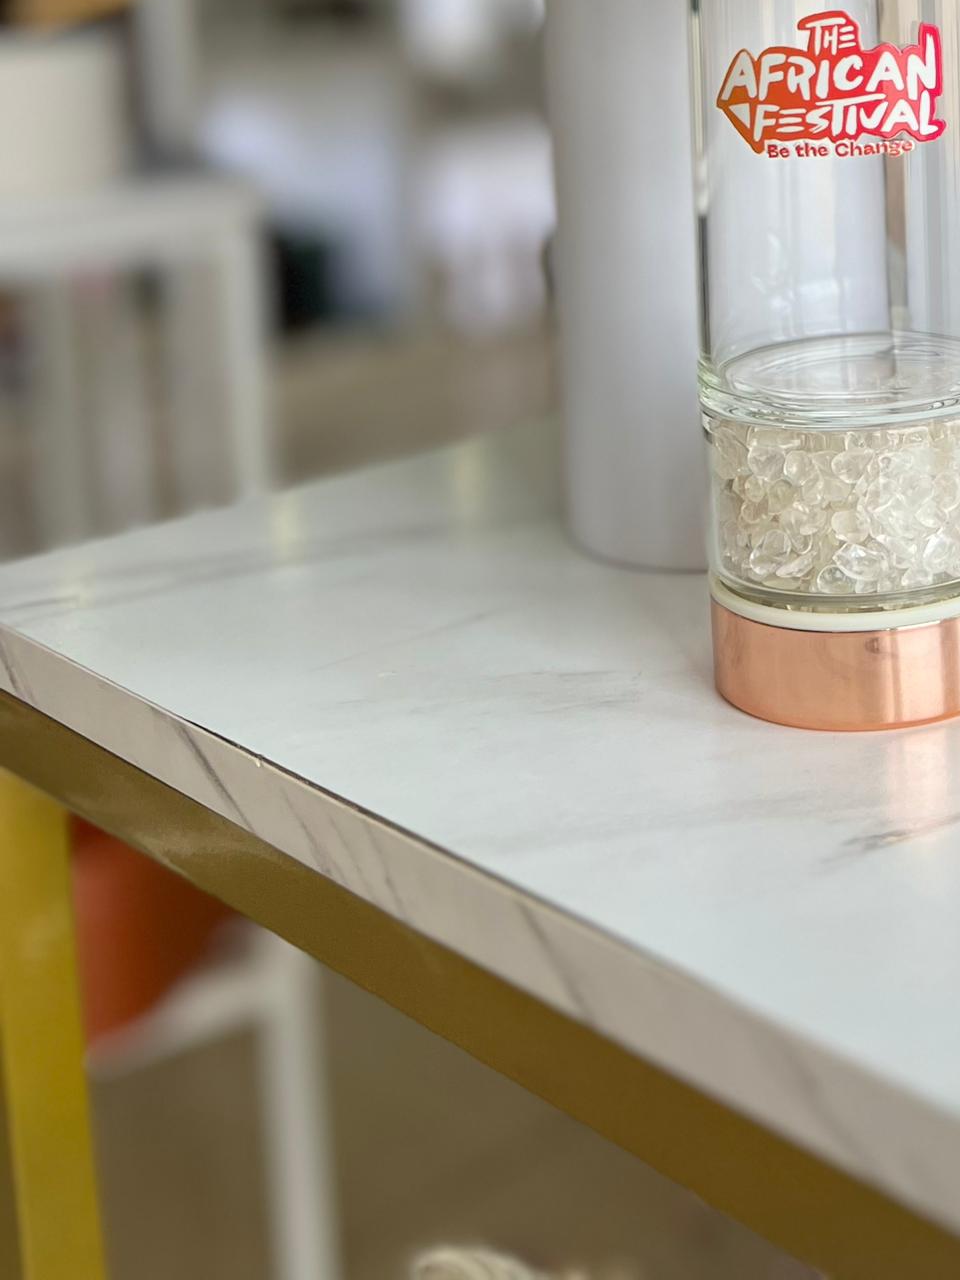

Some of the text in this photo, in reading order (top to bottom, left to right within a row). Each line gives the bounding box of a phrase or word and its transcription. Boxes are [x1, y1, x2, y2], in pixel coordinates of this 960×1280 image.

[804, 16, 858, 57] THE
[720, 32, 937, 102] AFRICAN
[752, 90, 939, 143] FESTIVAL
[766, 138, 915, 159] Be the Change
